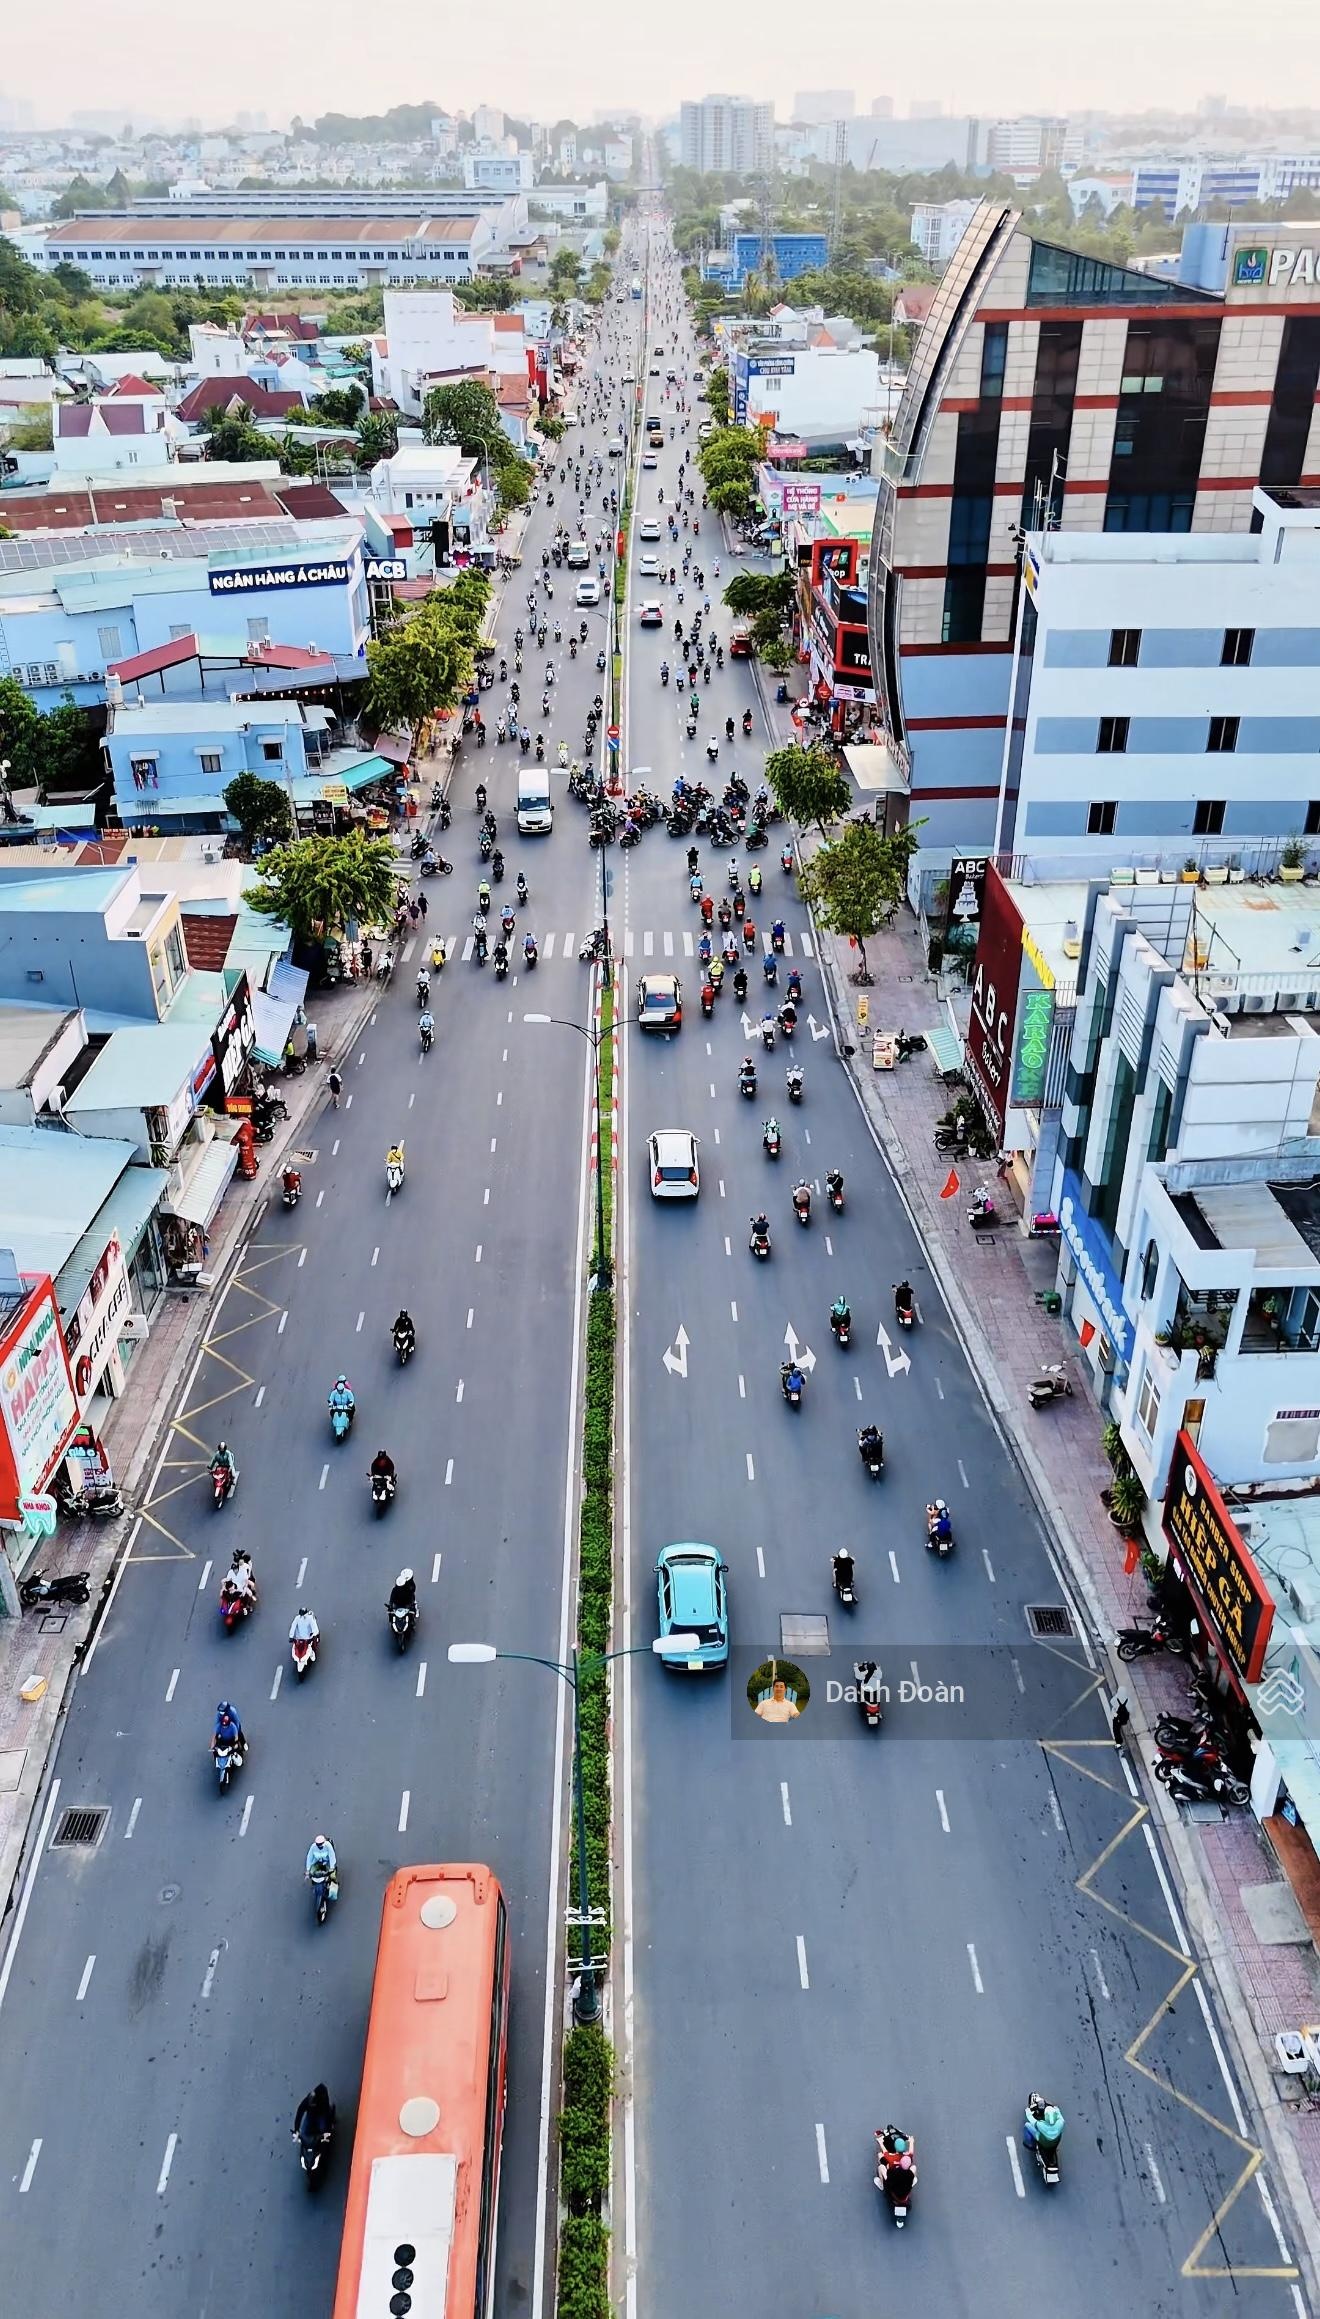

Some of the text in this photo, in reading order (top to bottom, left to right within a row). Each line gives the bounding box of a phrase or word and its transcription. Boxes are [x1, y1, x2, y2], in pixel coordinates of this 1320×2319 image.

[1268, 248, 1320, 286] PA
[212, 564, 346, 589] NGÂN HÀNG Á CHÂU
[366, 561, 406, 579] ACB
[854, 652, 872, 666] TR
[954, 860, 986, 874] ABC
[973, 963, 1009, 1054] ABC
[10, 1329, 60, 1426] HAPPY
[1199, 1497, 1251, 1603] BARBER SHOP
